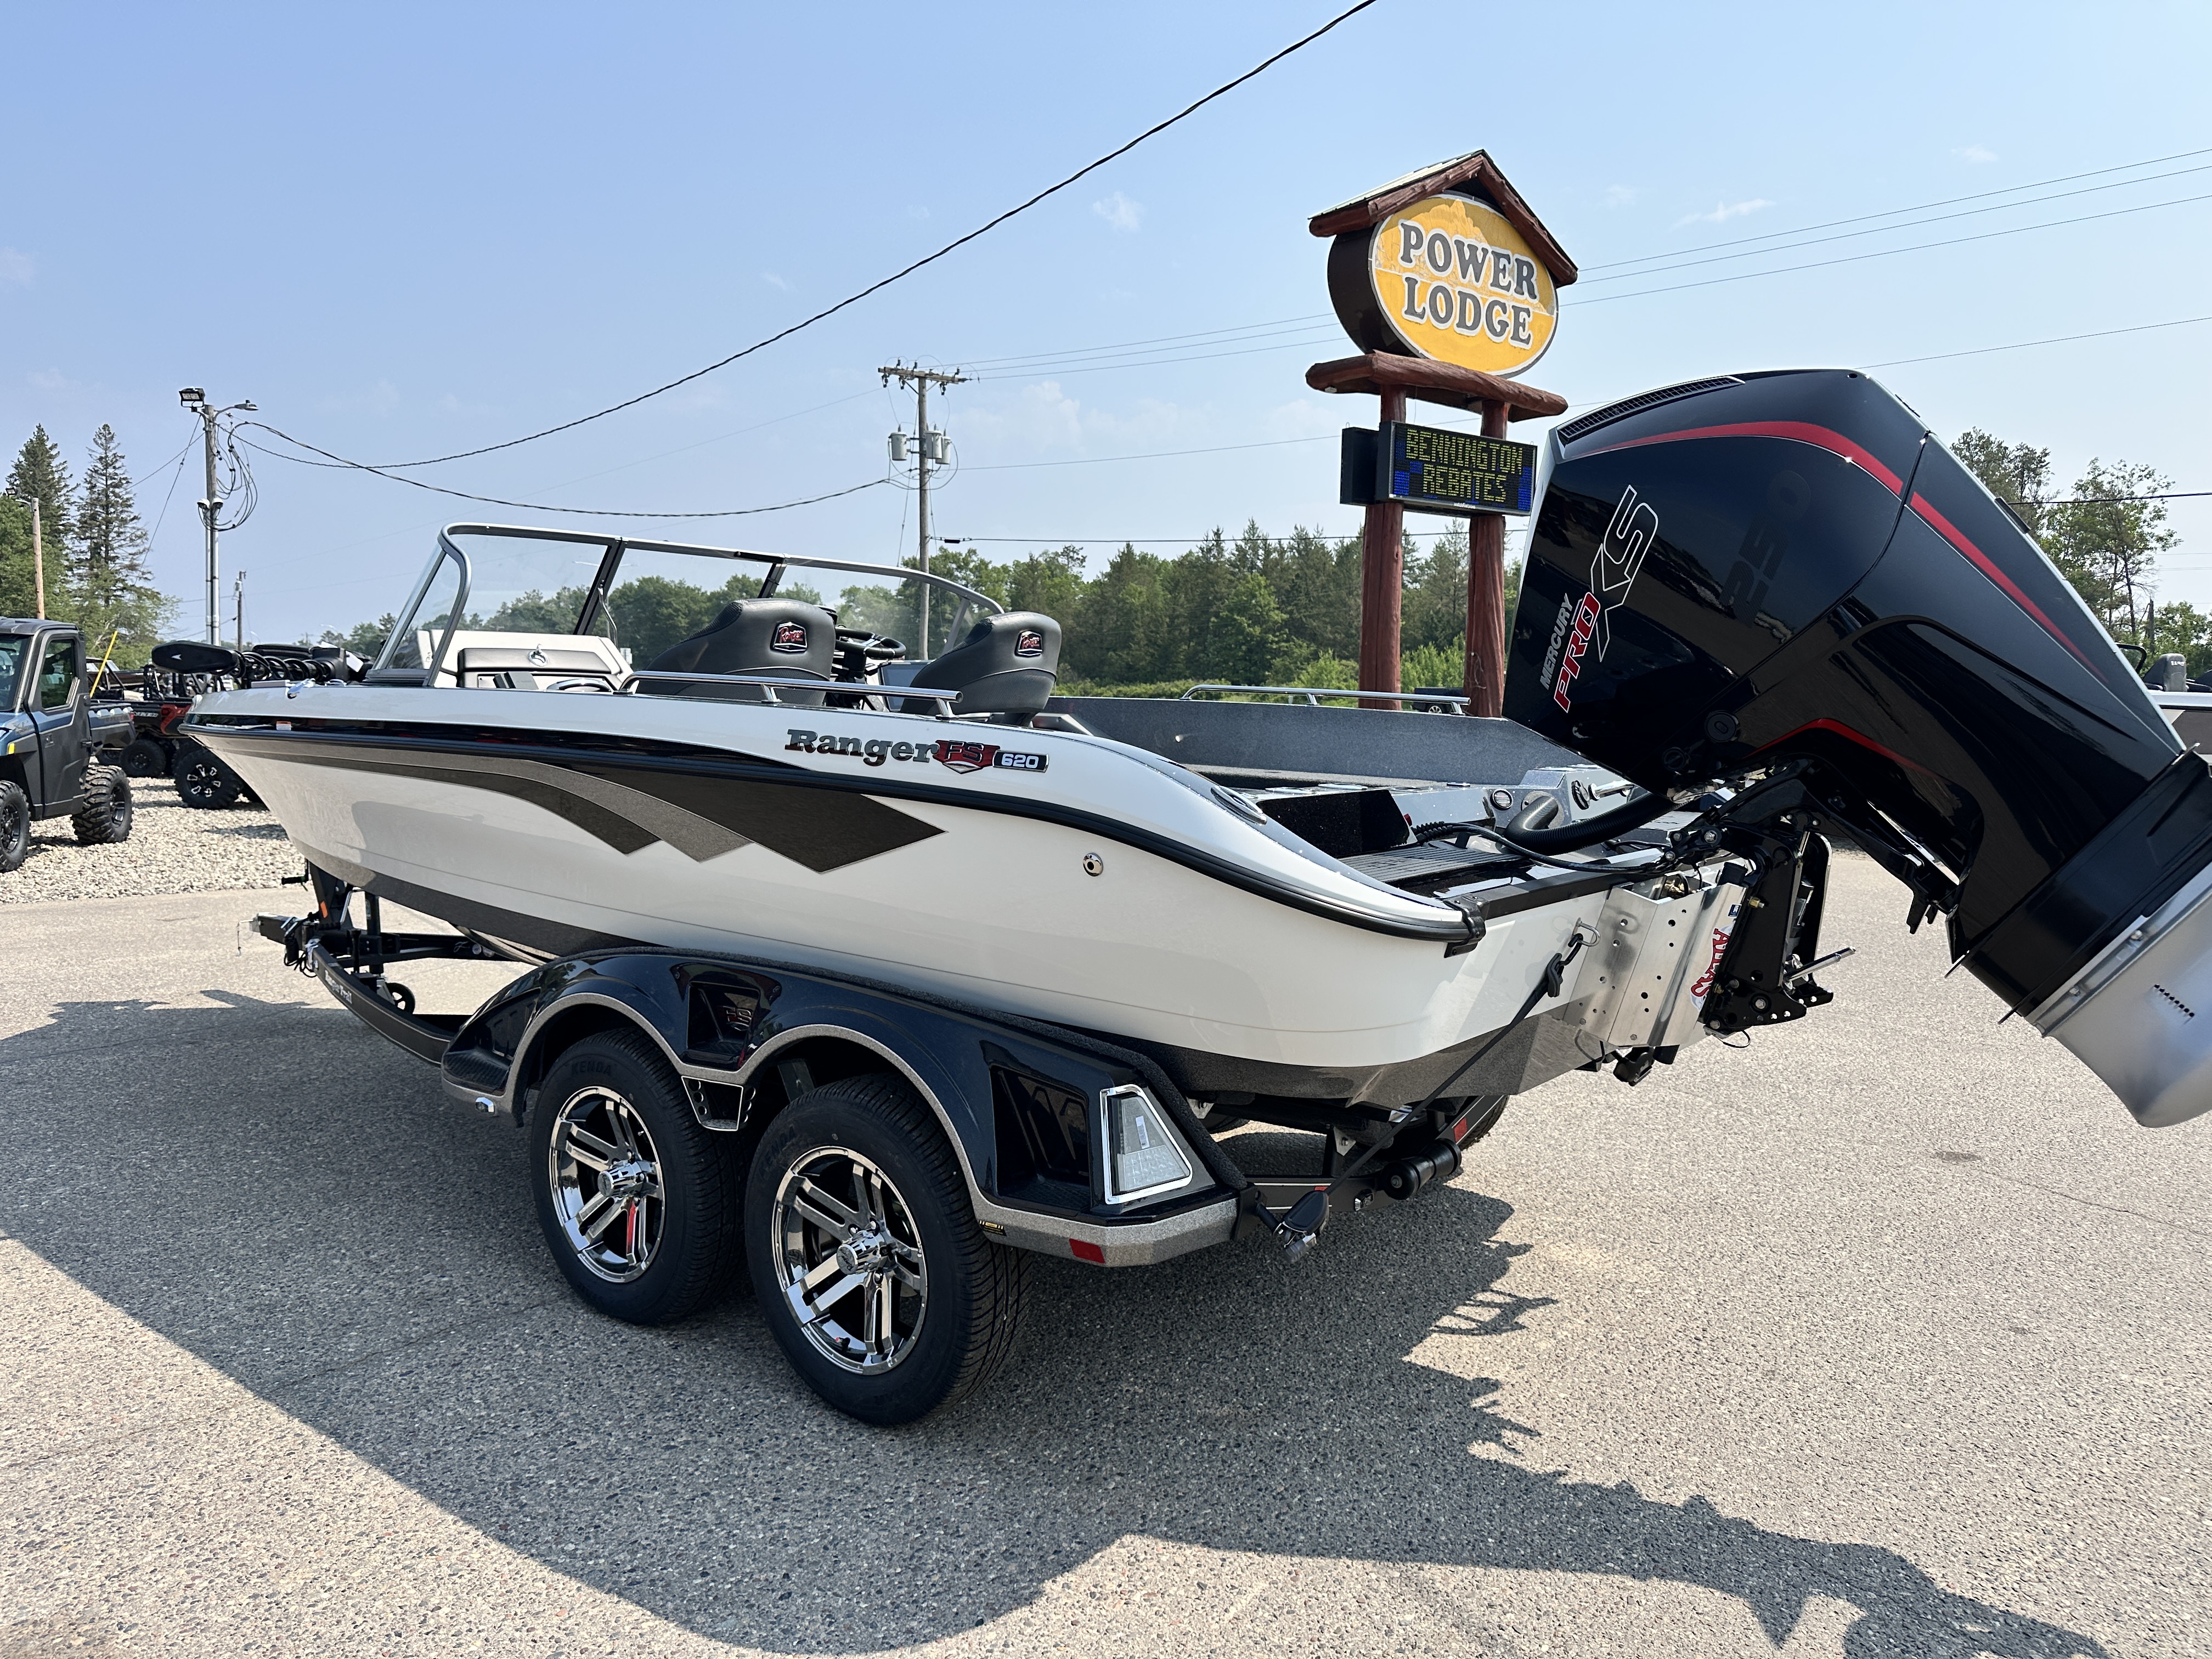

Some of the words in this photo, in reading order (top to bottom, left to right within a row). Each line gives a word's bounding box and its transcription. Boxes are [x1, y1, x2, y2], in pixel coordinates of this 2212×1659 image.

[1400, 222, 1538, 300] POWER
[1403, 276, 1532, 347] LODGE
[1406, 428, 1523, 475] BENNINGTON
[1423, 463, 1507, 503] REBATES
[1570, 484, 1659, 663] XS
[1539, 592, 1573, 691] MERCURY
[1554, 591, 1601, 713] PRO
[785, 728, 940, 767] Ranger
[944, 741, 985, 763] FS
[1000, 753, 1040, 769] 620
[571, 1060, 612, 1076] KENDA
